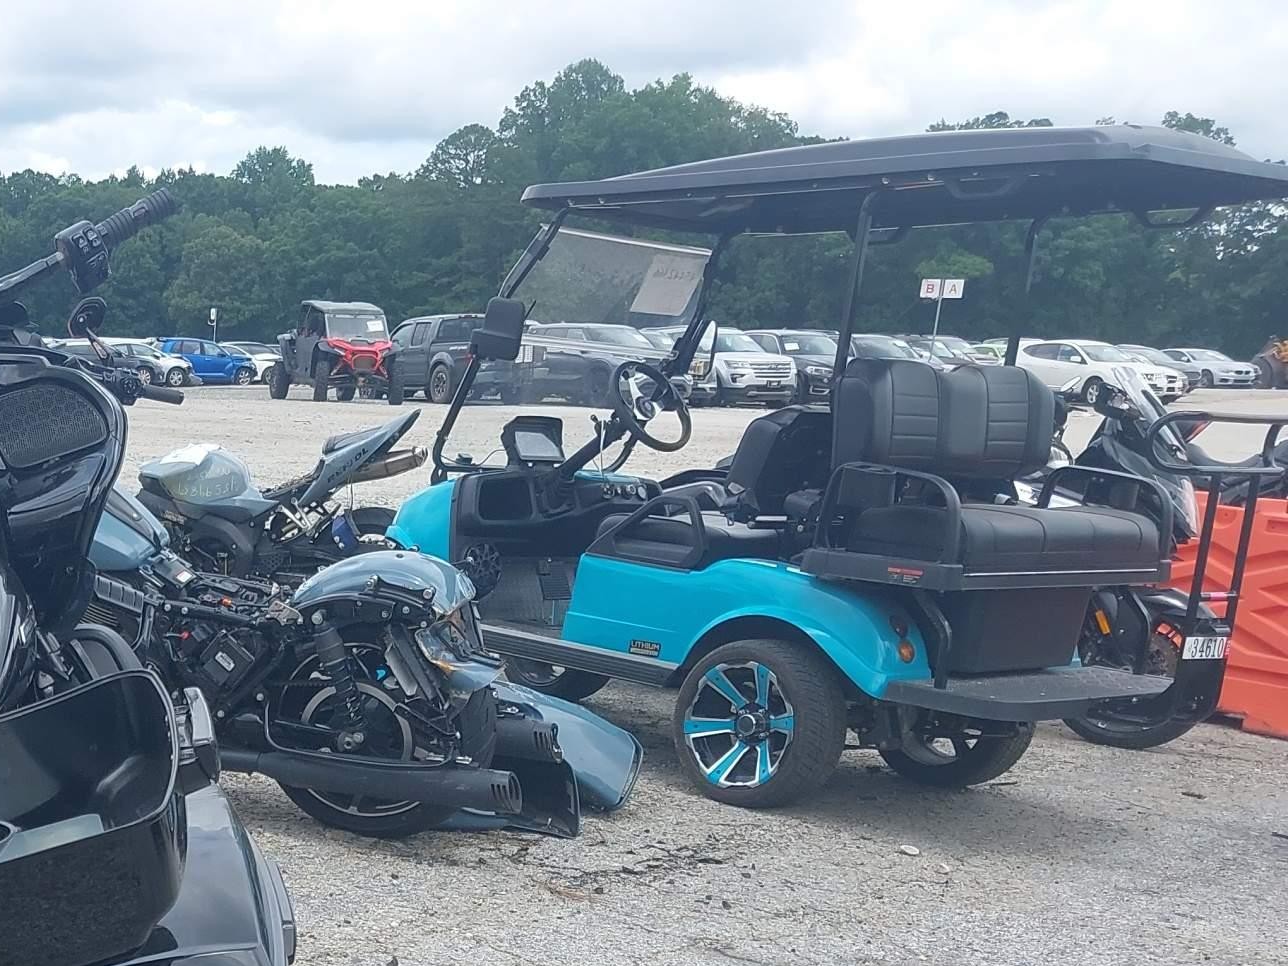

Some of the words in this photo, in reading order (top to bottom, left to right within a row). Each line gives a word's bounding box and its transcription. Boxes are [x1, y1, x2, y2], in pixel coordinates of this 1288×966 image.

[926, 283, 935, 294] B
[948, 283, 957, 295] A
[631, 640, 660, 650] LITHIUM
[1191, 638, 1224, 658] 34610
